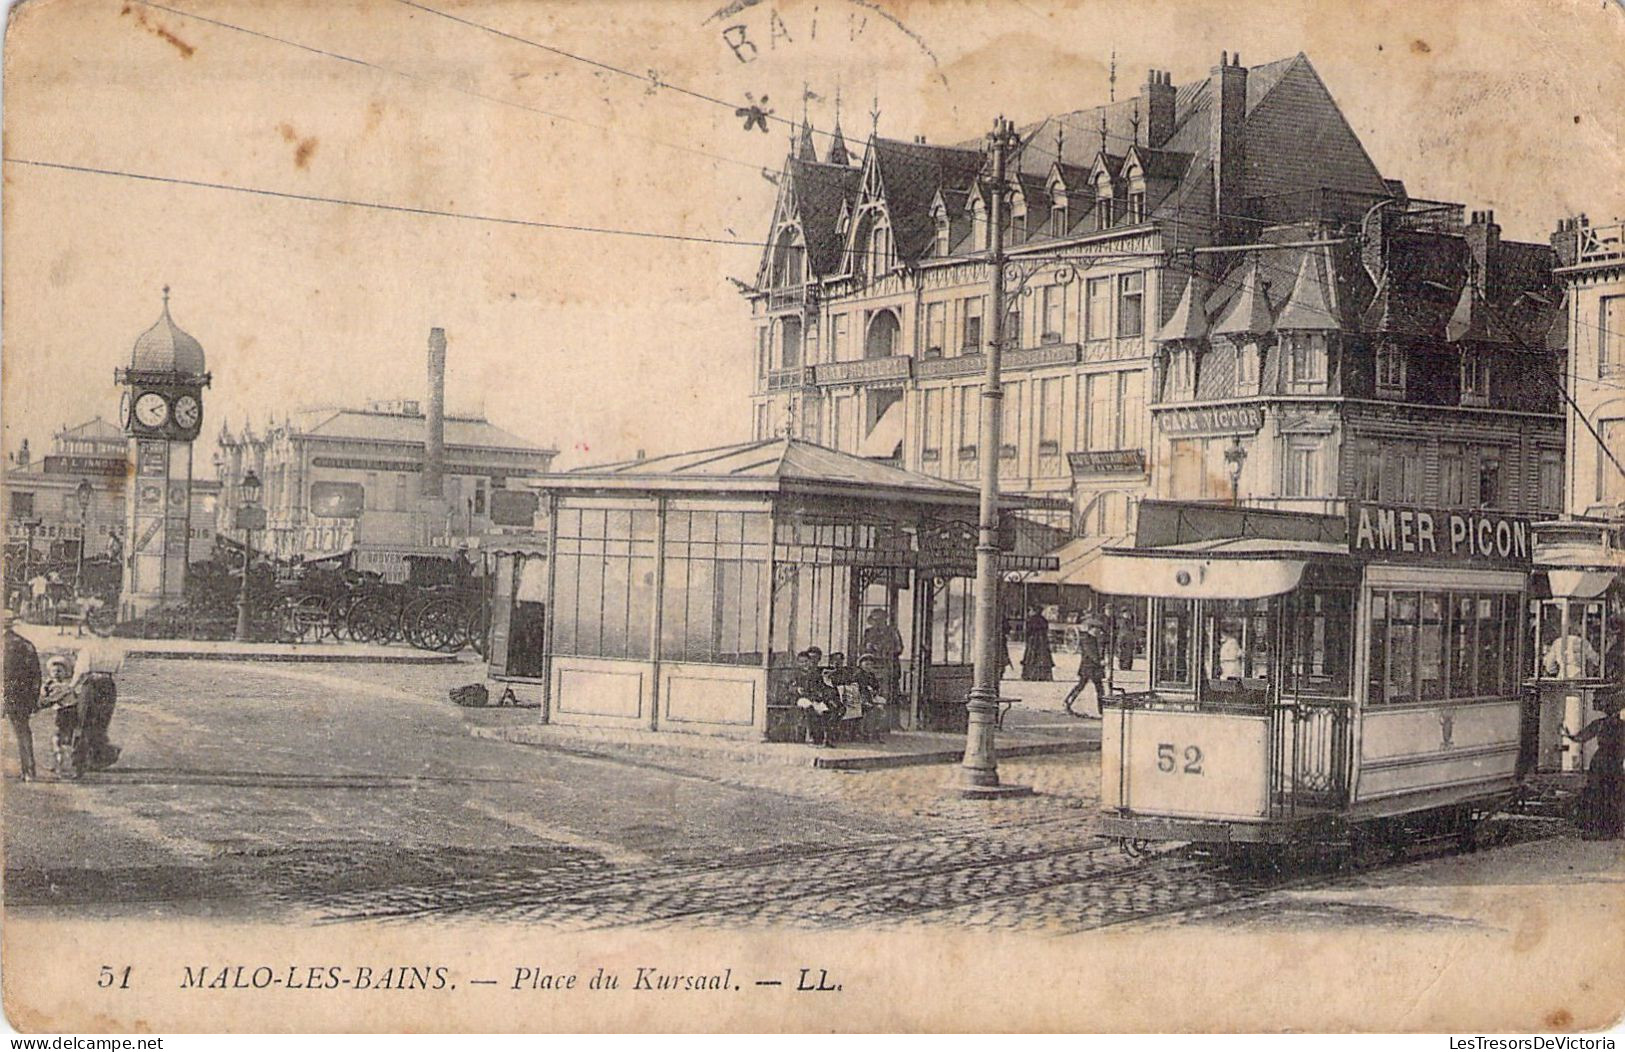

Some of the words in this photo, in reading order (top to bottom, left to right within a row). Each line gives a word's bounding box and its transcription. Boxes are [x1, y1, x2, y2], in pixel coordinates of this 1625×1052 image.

[1202, 408, 1260, 429] VICTOR
[1356, 507, 1436, 553] AMER
[1451, 515, 1527, 558] PICON
[1157, 743, 1205, 775] 52
